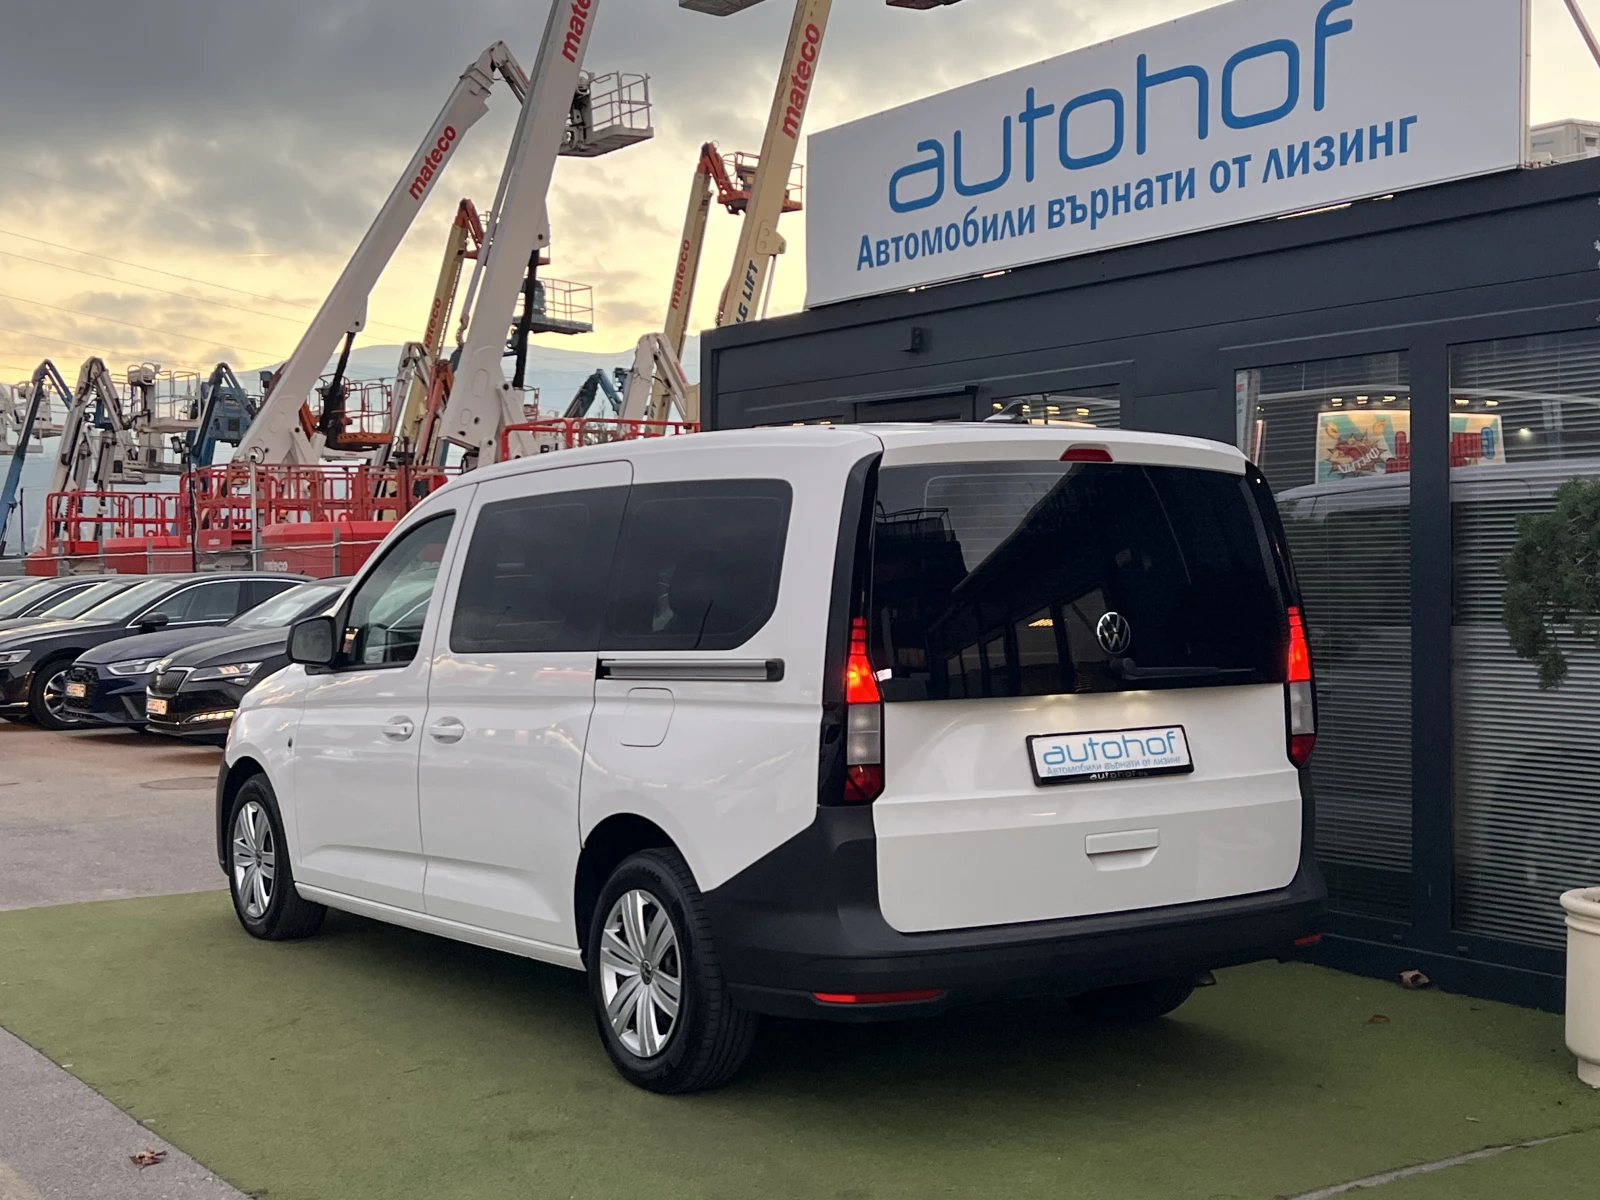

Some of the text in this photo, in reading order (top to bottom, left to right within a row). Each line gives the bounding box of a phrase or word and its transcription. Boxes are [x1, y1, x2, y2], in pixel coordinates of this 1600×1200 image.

[782, 23, 820, 140] mateco
[888, 0, 1353, 213] autohof
[408, 125, 456, 200] mateco
[857, 116, 1417, 269] Автомобили върнати от лизинг
[671, 239, 690, 310] mateco
[742, 259, 758, 302] LIFT
[1043, 730, 1176, 766] autohof
[1047, 763, 1102, 776] Автомобили
[1142, 758, 1151, 767] от
